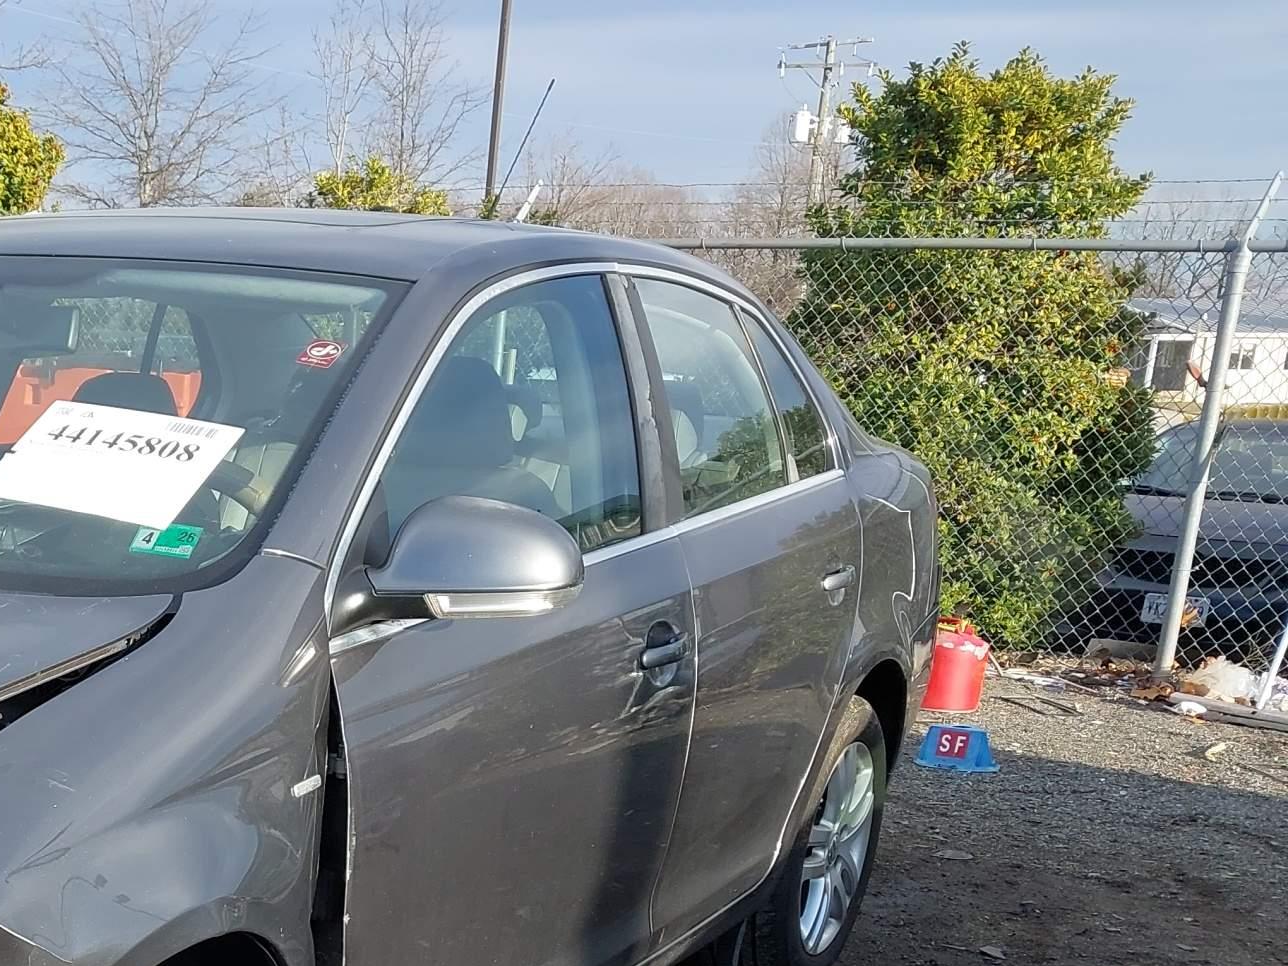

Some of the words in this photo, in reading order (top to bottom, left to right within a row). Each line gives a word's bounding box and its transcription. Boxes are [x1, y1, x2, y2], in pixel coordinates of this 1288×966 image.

[48, 424, 200, 462] 44145808
[142, 532, 155, 545] 4
[177, 531, 197, 544] 26
